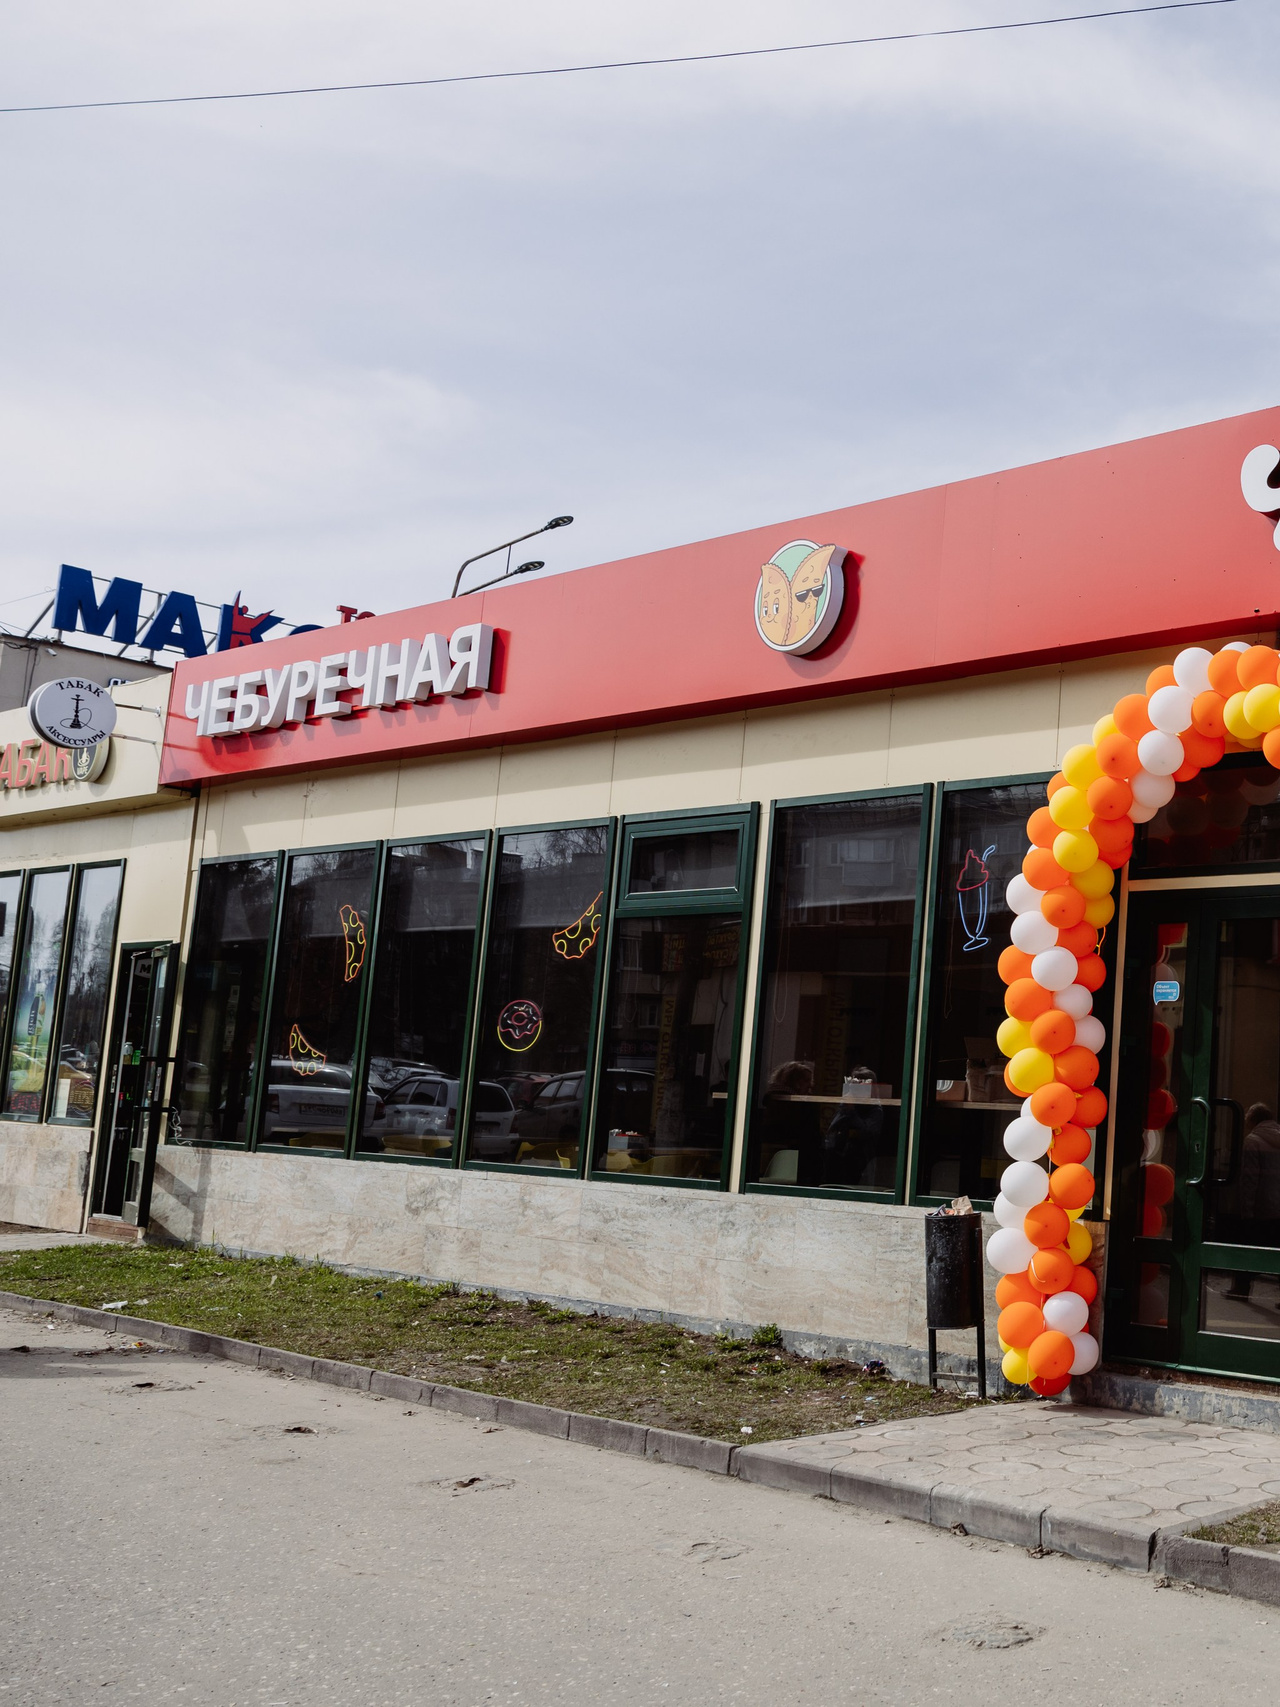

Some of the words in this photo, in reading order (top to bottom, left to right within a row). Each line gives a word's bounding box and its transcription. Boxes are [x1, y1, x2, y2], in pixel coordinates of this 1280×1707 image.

[55, 680, 104, 697] ТАБАК
[184, 623, 494, 737] ЧЕБУРЕЧНАЯ
[46, 726, 106, 746] АКСЕССУАРЫ
